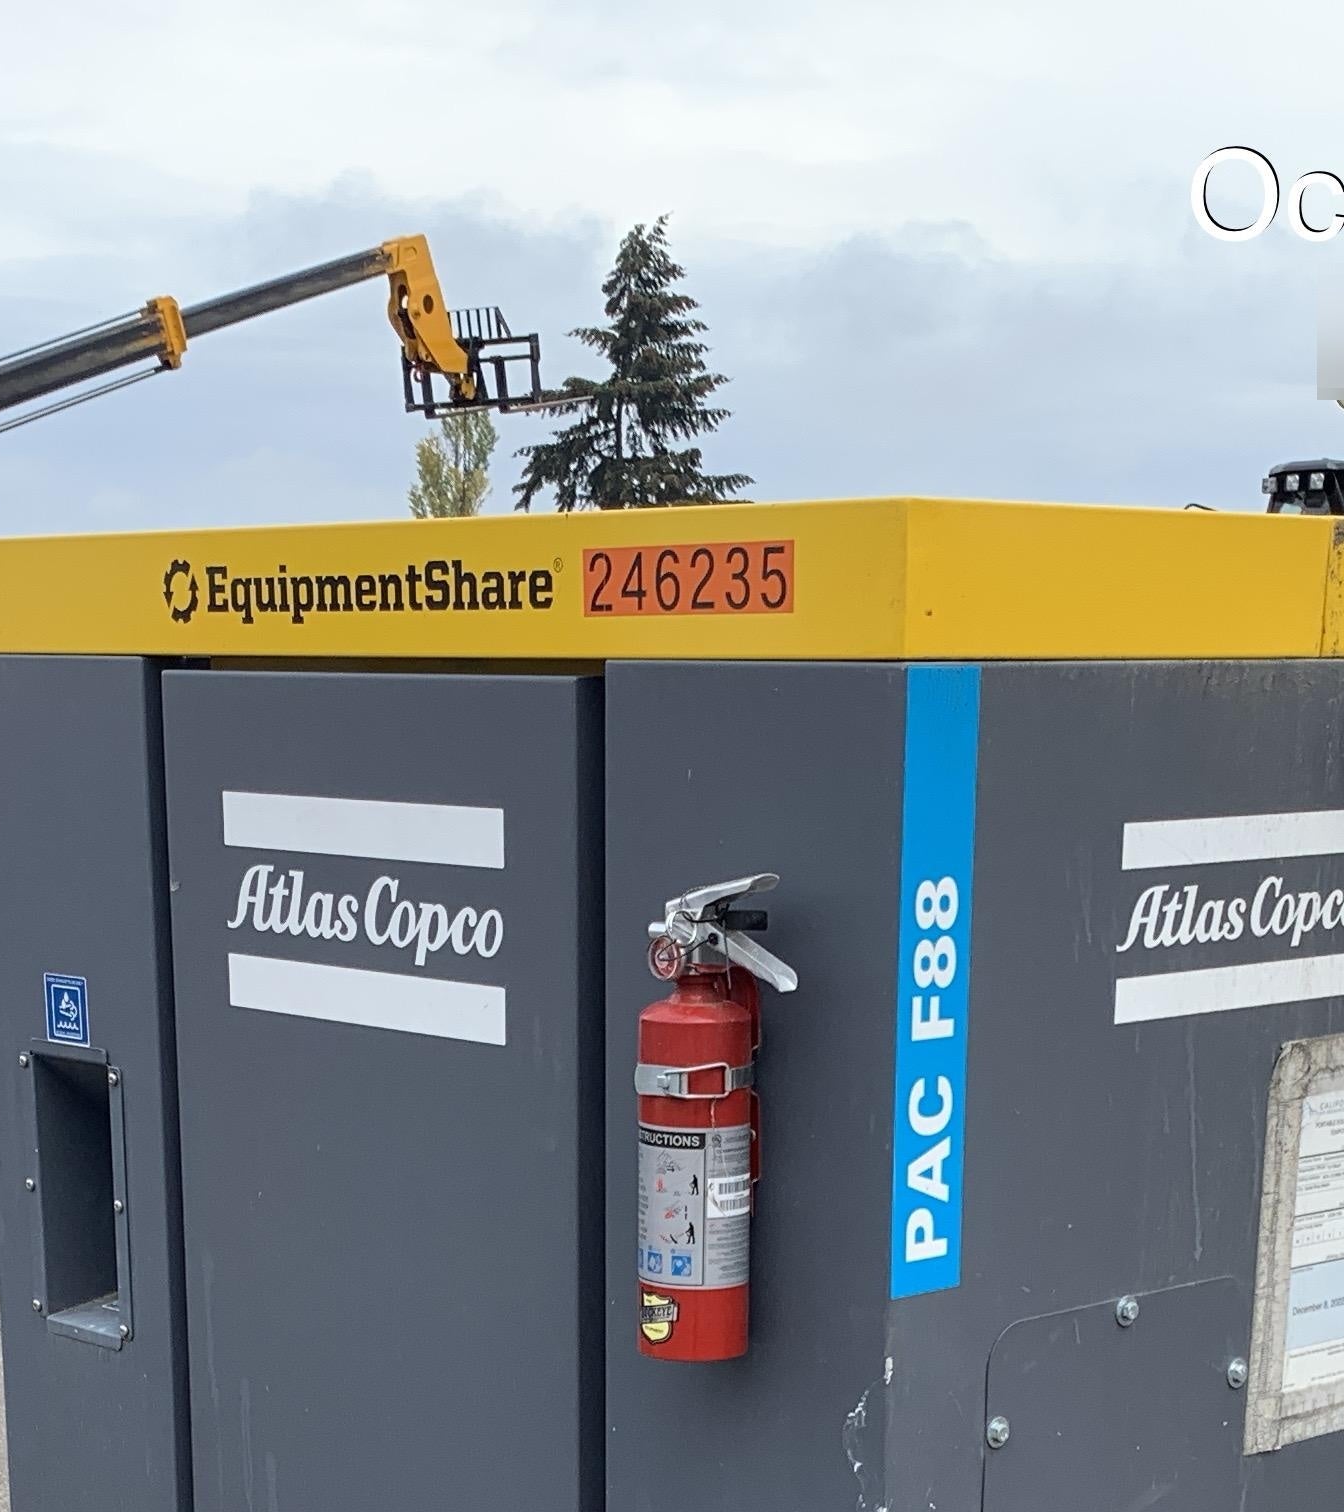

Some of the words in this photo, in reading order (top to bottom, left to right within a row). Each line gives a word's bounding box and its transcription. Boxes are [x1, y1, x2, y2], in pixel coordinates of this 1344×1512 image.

[207, 560, 554, 624] EquipmentShare
[589, 545, 789, 612] 246235
[227, 864, 359, 942] Atlas
[364, 875, 504, 967] Copco
[1116, 884, 1247, 952] Atlas
[911, 875, 960, 1043] F88
[905, 1074, 954, 1264] PAC
